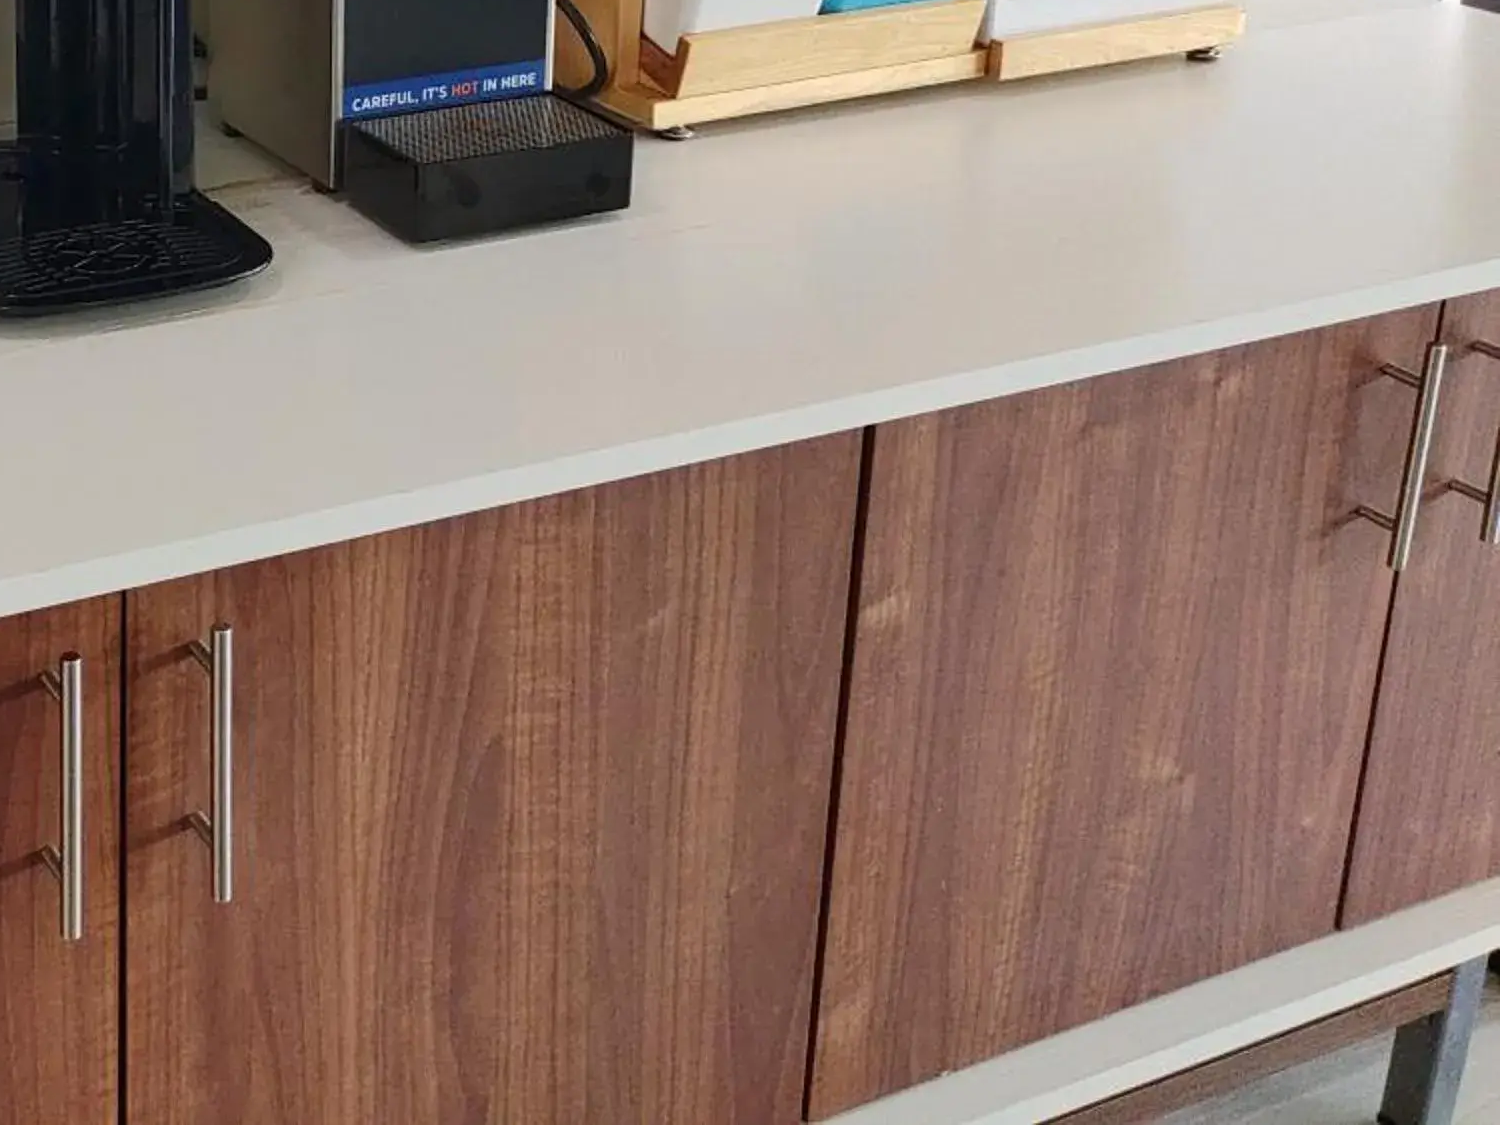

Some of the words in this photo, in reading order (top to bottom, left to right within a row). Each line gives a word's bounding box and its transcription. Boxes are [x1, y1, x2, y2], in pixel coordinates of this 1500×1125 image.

[352, 90, 419, 112] CAREFUL,
[422, 85, 448, 101] IT'S
[451, 81, 479, 97] HOT
[483, 77, 498, 92] IN
[501, 72, 537, 90] HERE
